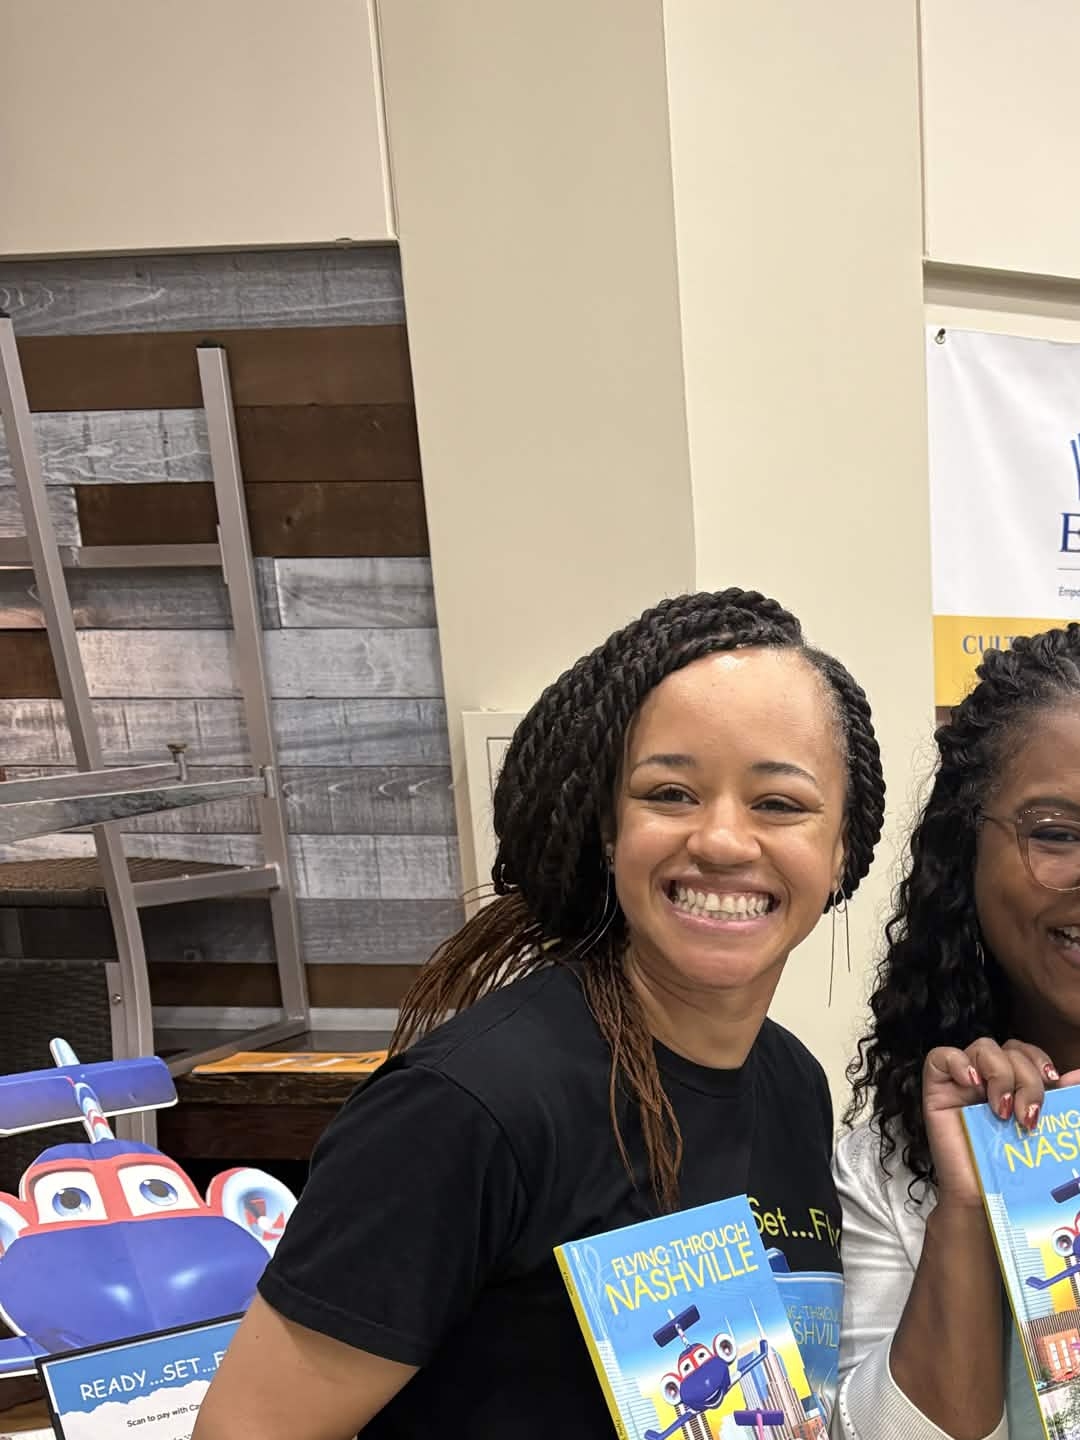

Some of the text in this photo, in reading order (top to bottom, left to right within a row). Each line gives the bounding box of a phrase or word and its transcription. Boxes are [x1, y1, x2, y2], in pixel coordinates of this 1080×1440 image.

[604, 1240, 759, 1316] NASHVILLE
[611, 1220, 750, 1279] FLYING THROUGH
[126, 1417, 146, 1428] Scan
[147, 1415, 155, 1423] to
[156, 1411, 170, 1422] pay
[172, 1406, 189, 1416] with
